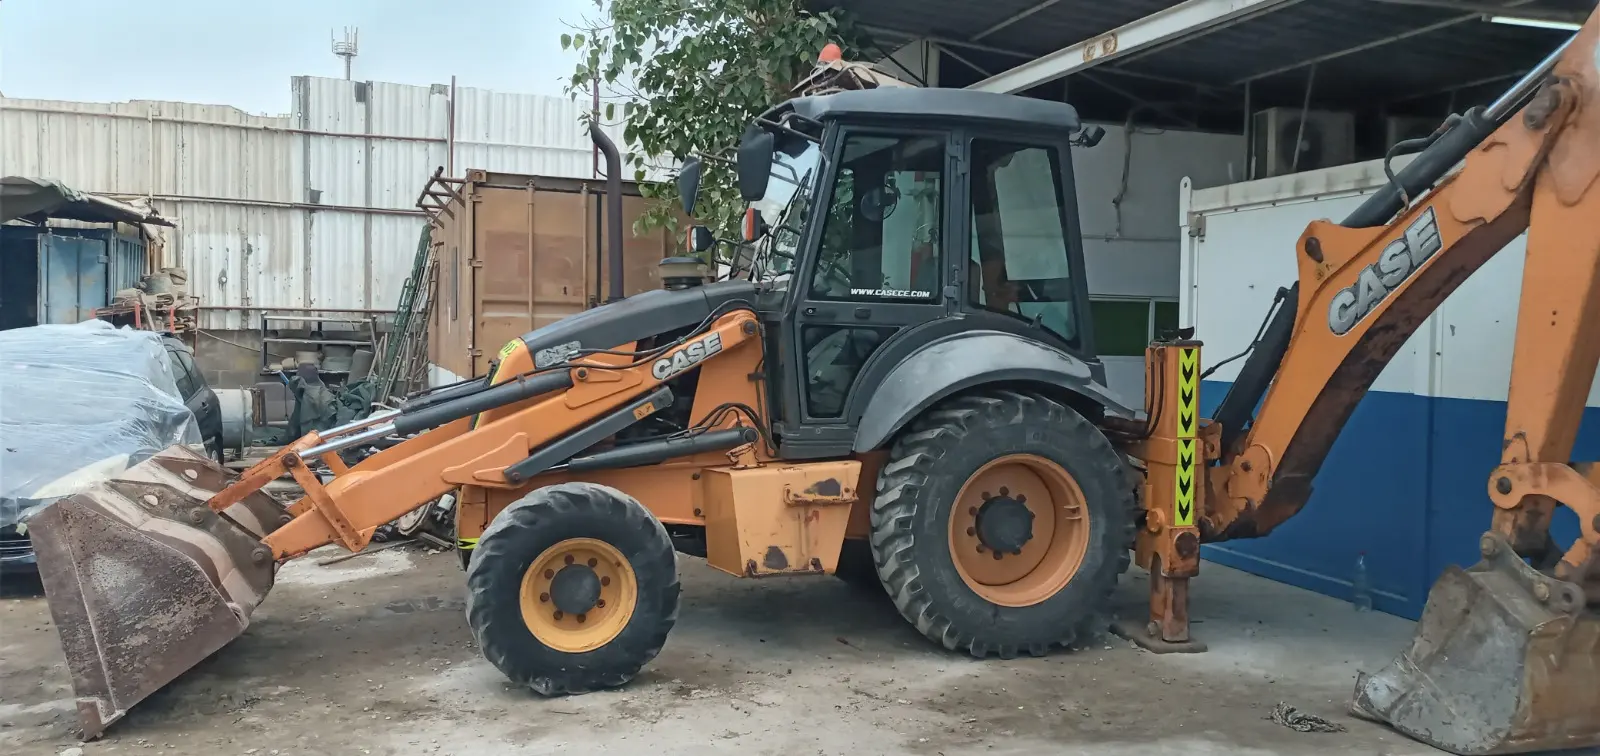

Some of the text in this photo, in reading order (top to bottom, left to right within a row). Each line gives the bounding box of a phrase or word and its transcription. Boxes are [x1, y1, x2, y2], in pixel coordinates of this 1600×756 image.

[850, 288, 930, 298] WWW.CASECE.COM
[1329, 206, 1442, 335] CASE
[652, 332, 723, 379] CASE
